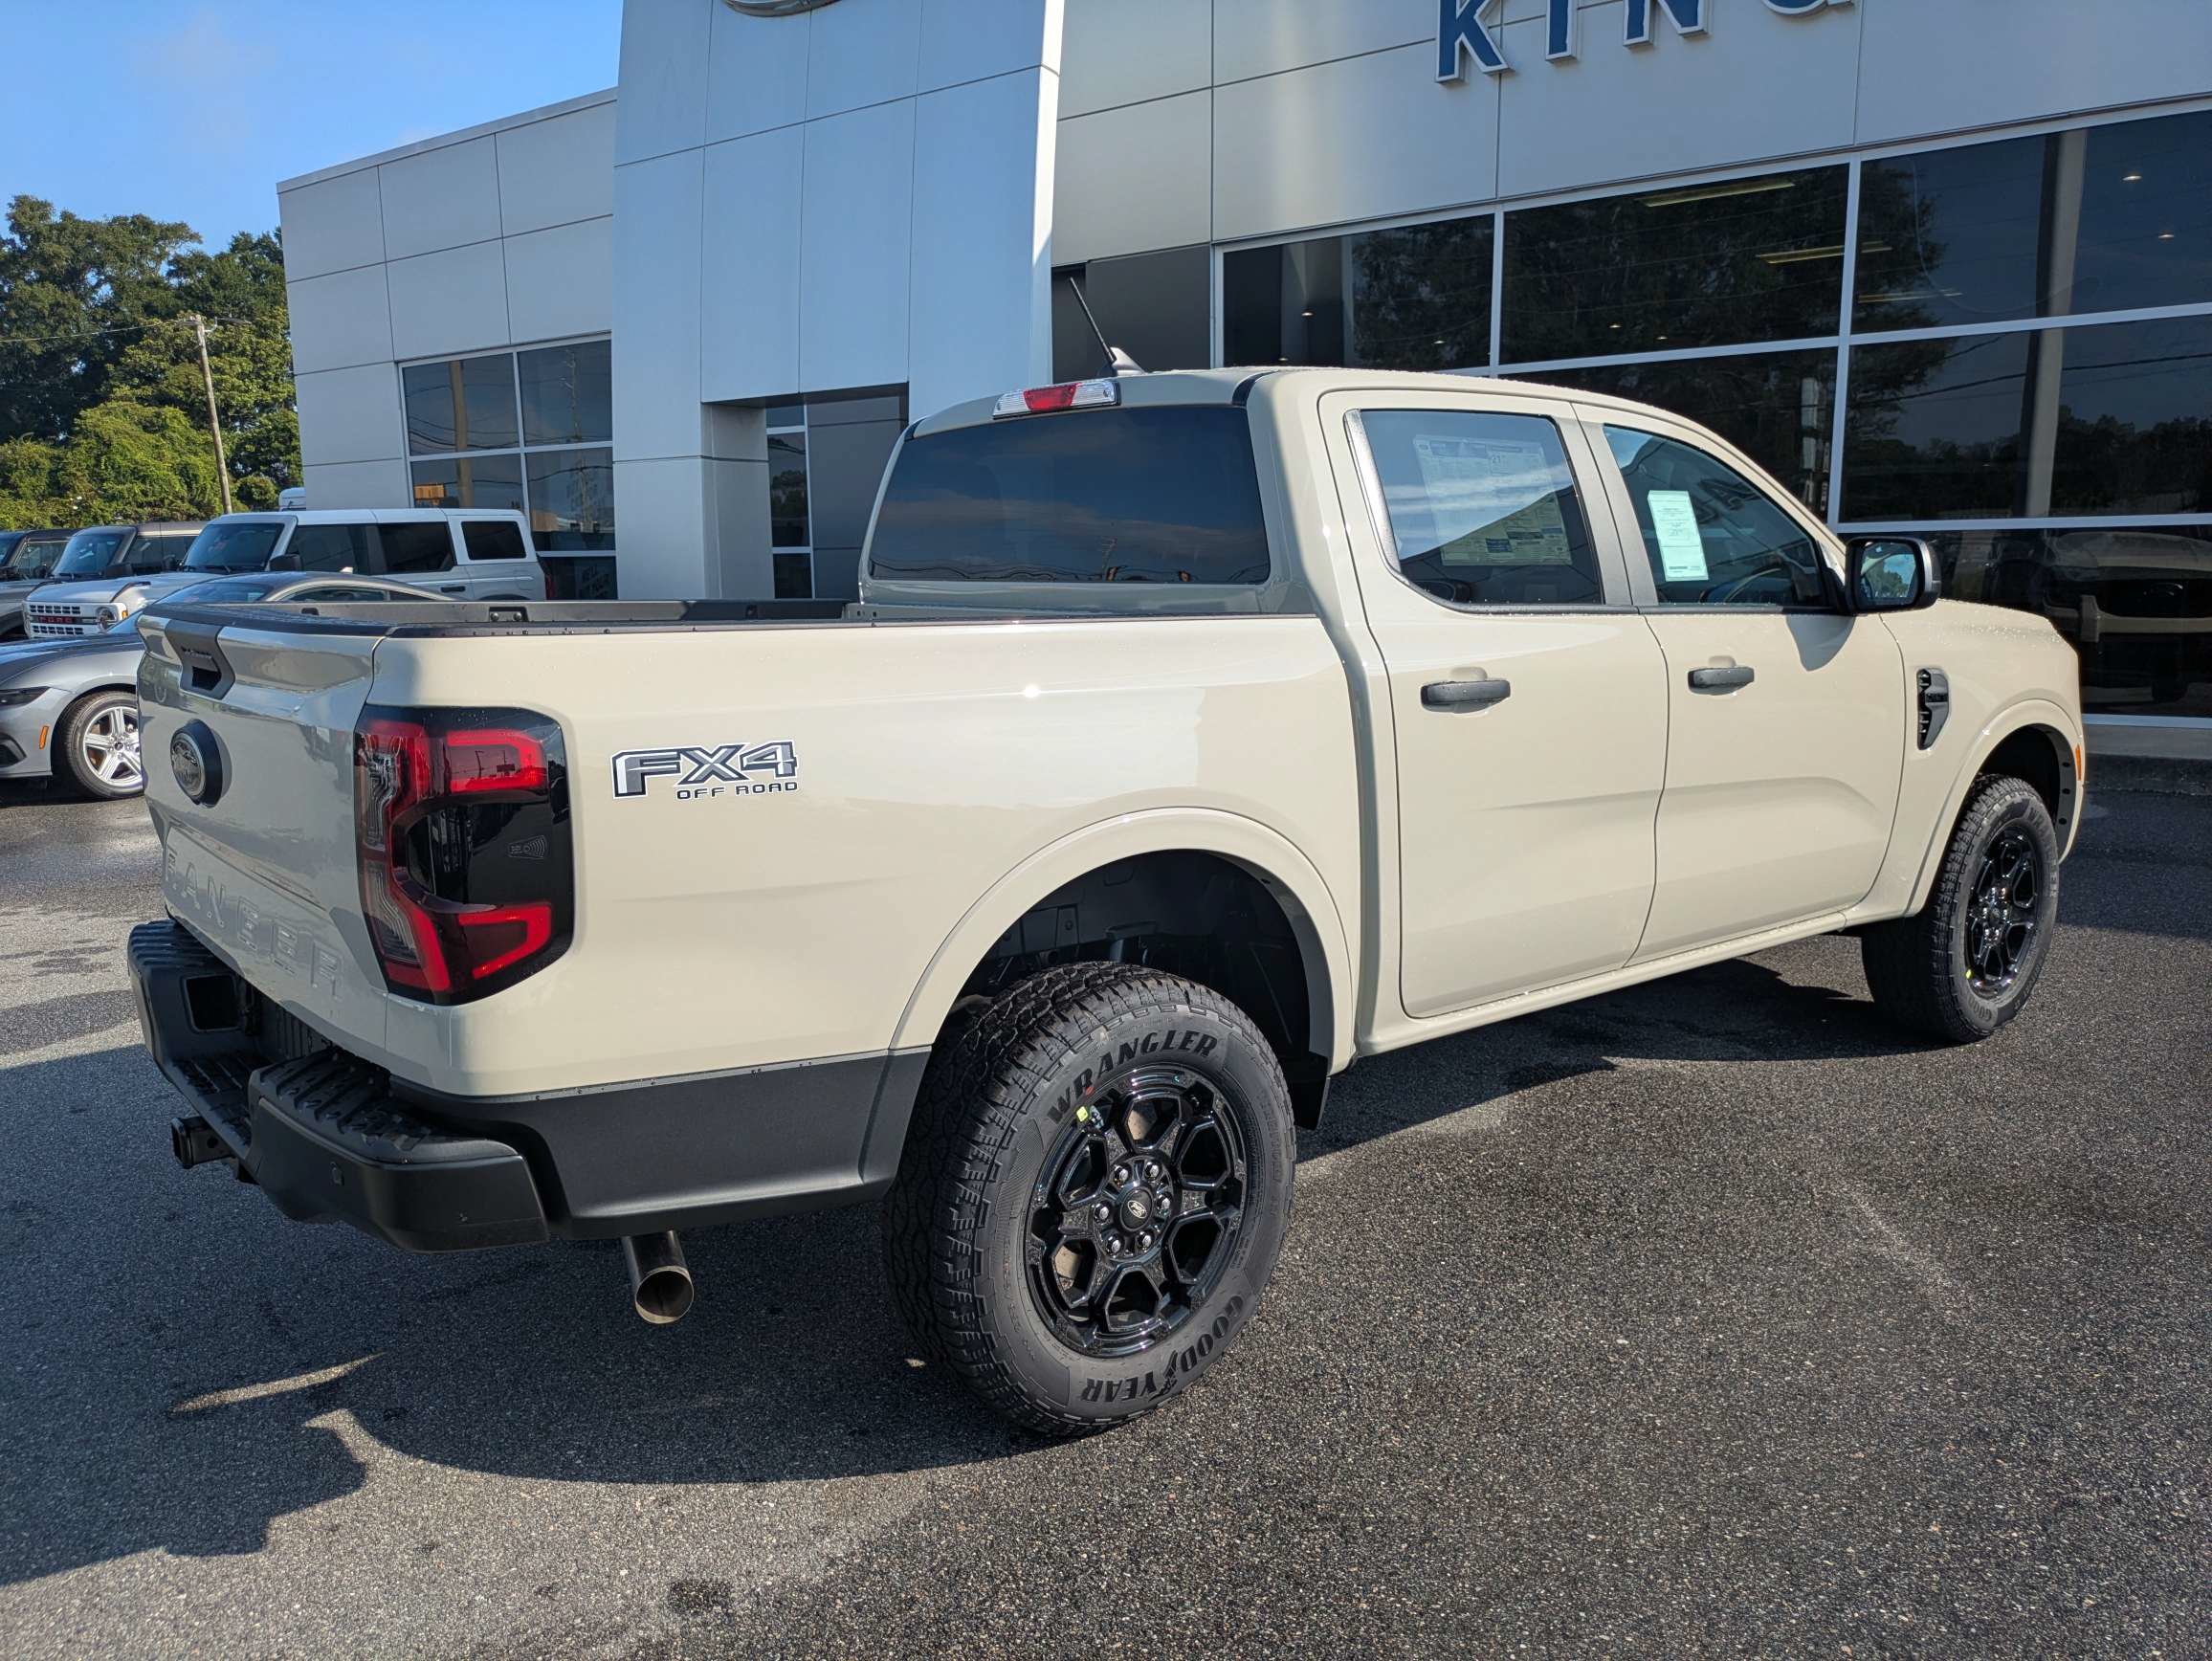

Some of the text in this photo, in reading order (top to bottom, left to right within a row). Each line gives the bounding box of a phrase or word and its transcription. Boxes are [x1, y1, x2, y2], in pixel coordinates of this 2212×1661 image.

[1436, 0, 1852, 84] KI
[611, 740, 798, 799] FX4
[676, 781, 798, 800] OFF ROAD
[166, 845, 343, 1000] RANGER
[1047, 1030, 1218, 1124] WRANGLER
[1080, 1295, 1244, 1403] GOODYEAR
